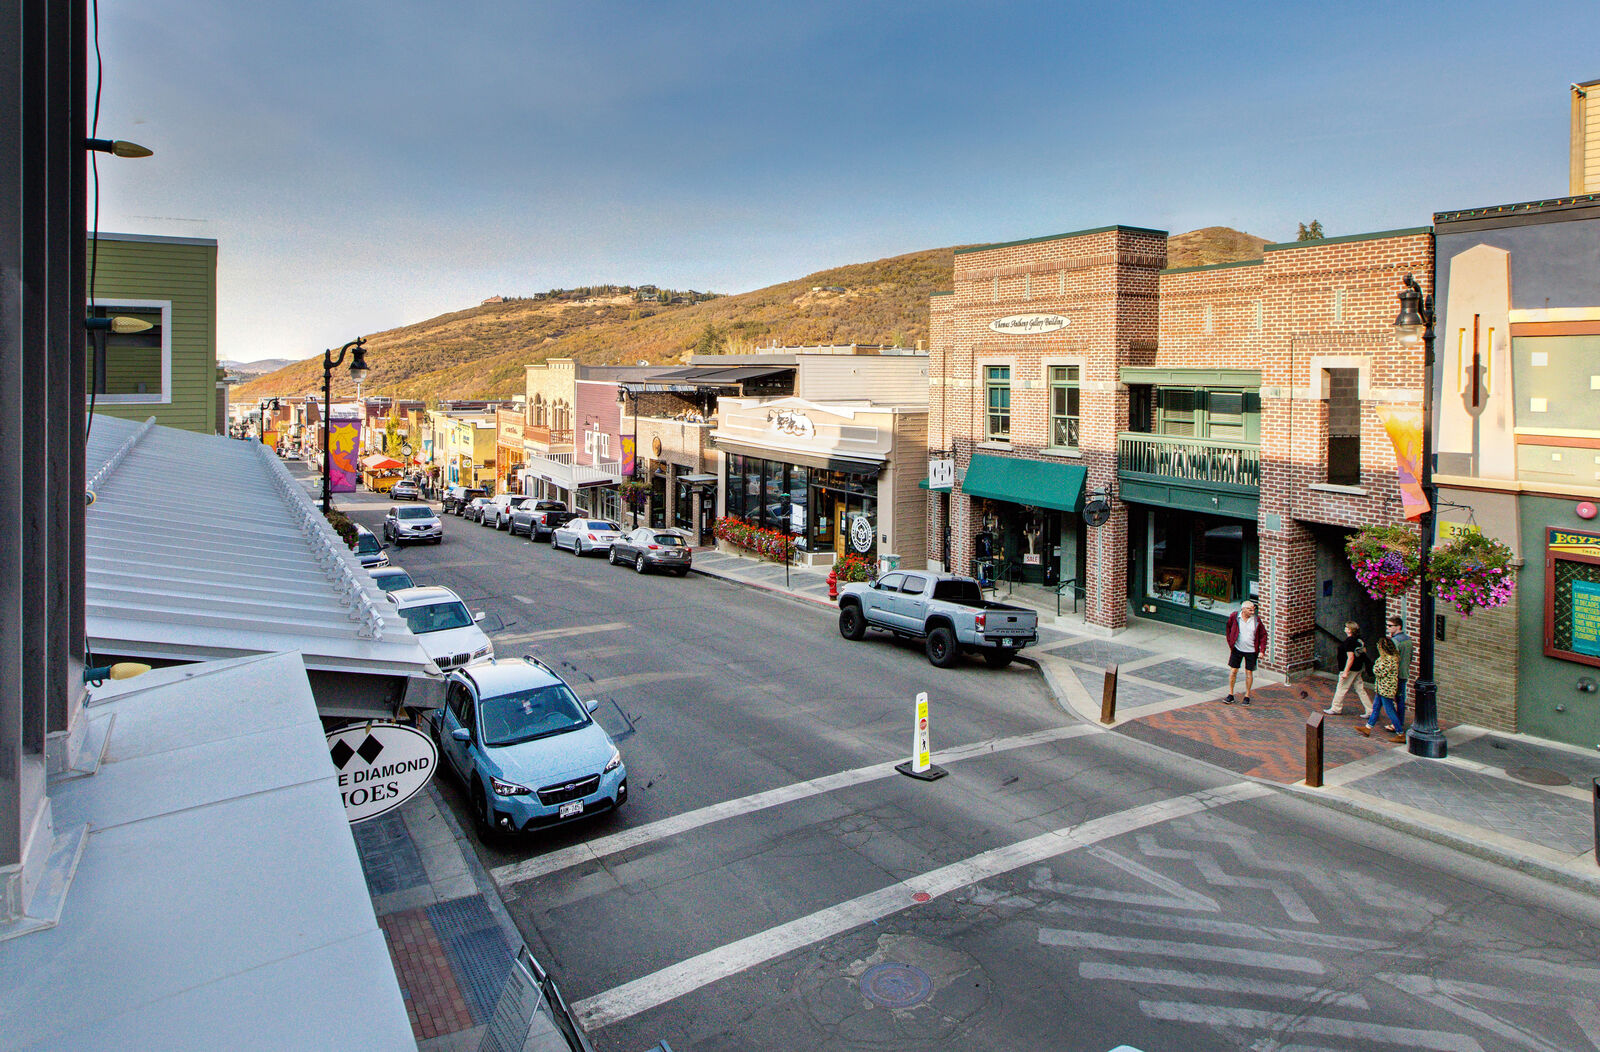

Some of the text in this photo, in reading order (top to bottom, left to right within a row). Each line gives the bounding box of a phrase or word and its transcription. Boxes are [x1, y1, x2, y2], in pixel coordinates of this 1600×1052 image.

[1045, 316, 1064, 329] Building
[1449, 526, 1471, 536] 330
[354, 757, 429, 783] DIAMOND
